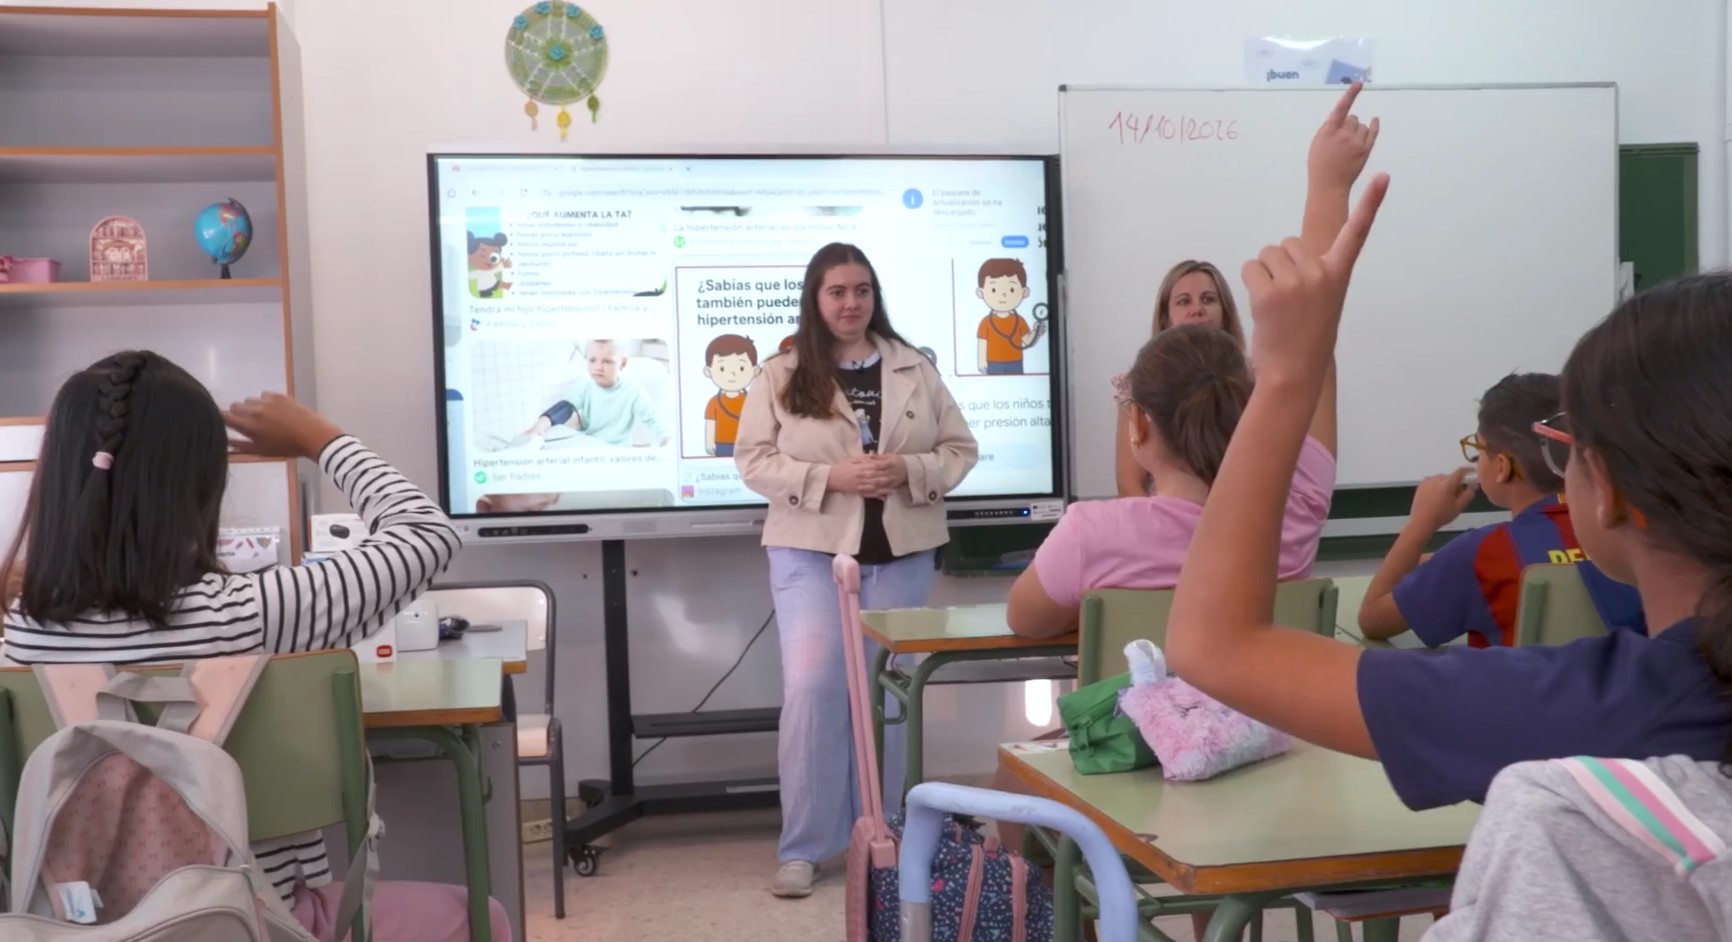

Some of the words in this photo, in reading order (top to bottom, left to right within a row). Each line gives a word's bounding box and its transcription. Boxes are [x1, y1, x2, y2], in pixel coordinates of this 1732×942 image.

[553, 210, 599, 219] AUMENTA
[601, 210, 613, 219] LA
[687, 222, 743, 233] hipertensión
[755, 281, 781, 293] que
[783, 278, 804, 291] los
[696, 296, 753, 309] también
[757, 295, 800, 310] puede
[517, 305, 534, 315] hijo
[697, 313, 783, 328] hipertensión
[968, 401, 990, 411] que
[993, 399, 1010, 409] los
[1013, 397, 1044, 409] niños
[984, 415, 1027, 430] presión
[473, 457, 533, 468] Hipertensión
[536, 456, 570, 466] arterial
[609, 454, 642, 463] valores
[977, 453, 994, 461] are
[510, 472, 541, 481] Padres
